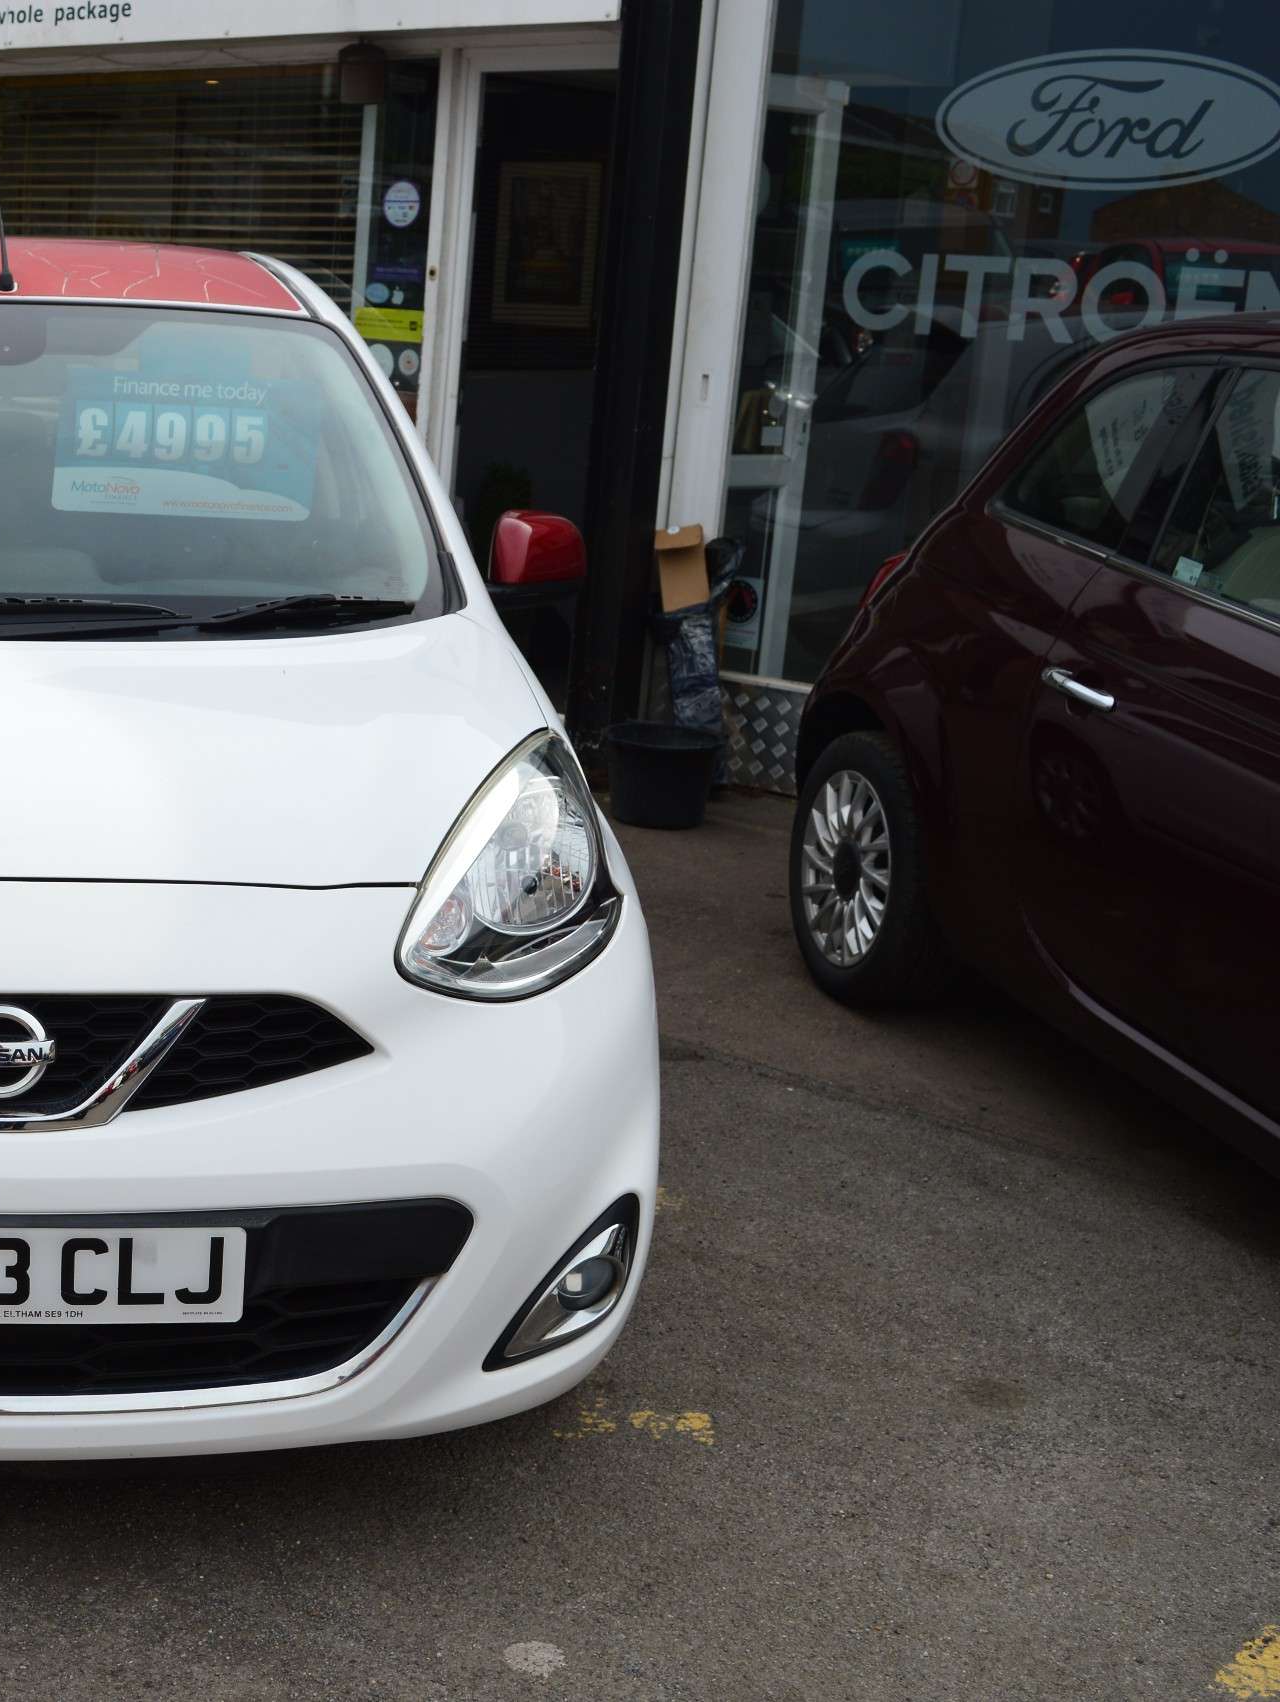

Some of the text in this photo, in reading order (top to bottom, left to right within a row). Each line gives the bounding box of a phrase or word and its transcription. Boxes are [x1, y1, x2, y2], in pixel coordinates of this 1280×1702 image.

[54, 2, 132, 26] package
[1005, 74, 1215, 160] Ford
[113, 376, 181, 397] Finance
[183, 384, 212, 398] me
[76, 407, 265, 464] £4995
[60, 1236, 225, 1306] CLJ
[44, 1310, 62, 1318] SE9
[65, 1310, 83, 1318] 1DH
